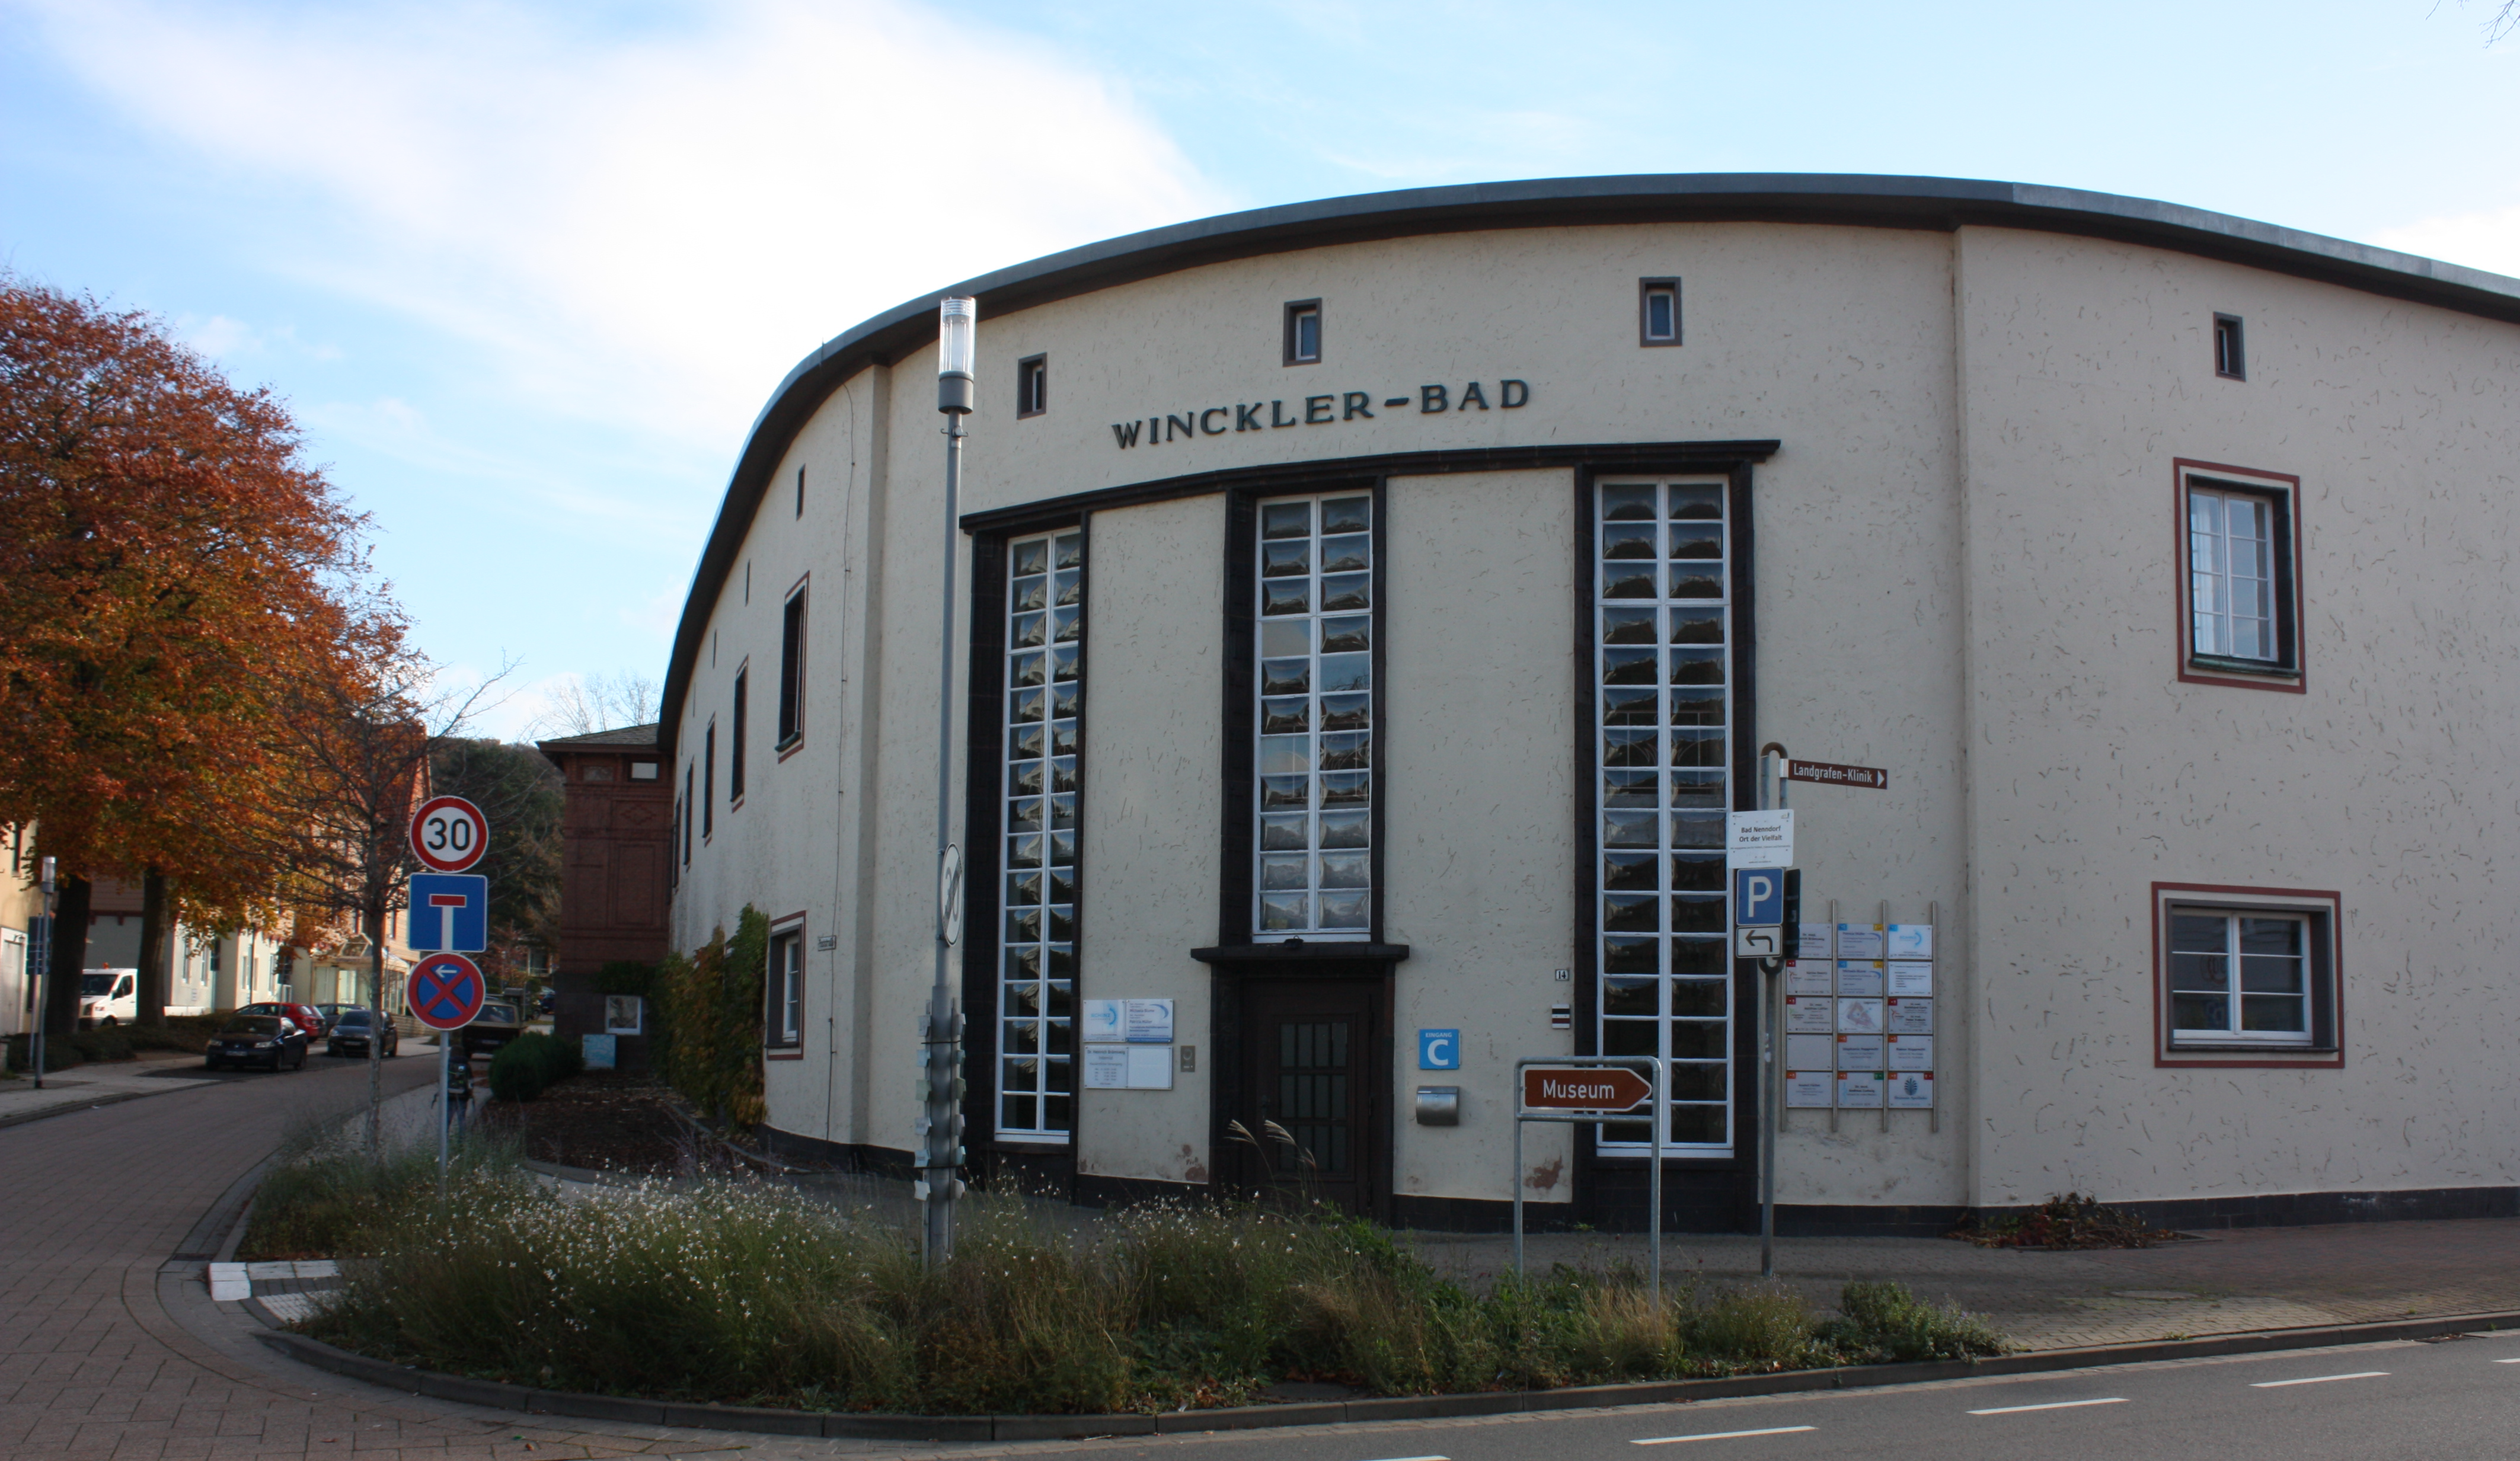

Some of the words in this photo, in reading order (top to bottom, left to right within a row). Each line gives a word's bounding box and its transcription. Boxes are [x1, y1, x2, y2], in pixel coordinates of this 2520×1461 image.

[1793, 763, 1873, 784] Landgrafen-Klinik
[427, 817, 471, 851] 30
[1748, 875, 1772, 917] P
[1557, 970, 1567, 980] 14
[1427, 1039, 1449, 1066] C
[1542, 1079, 1615, 1100] Museum
